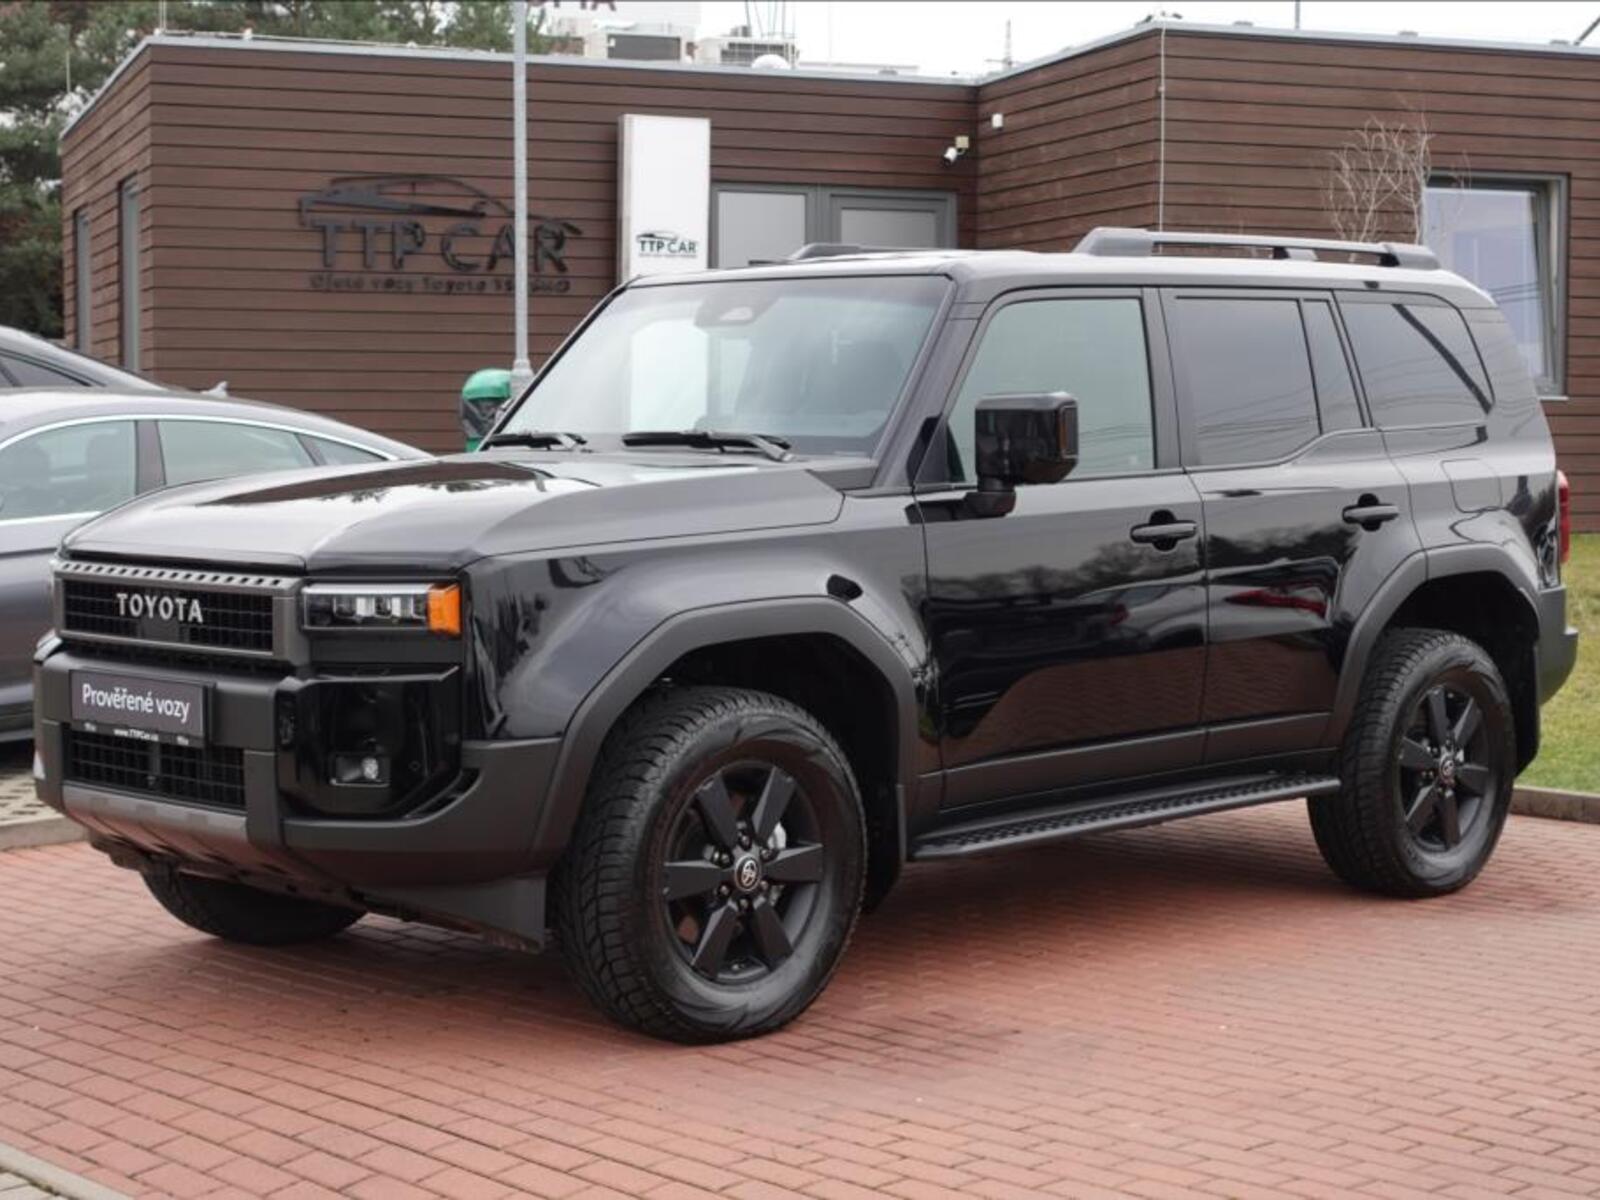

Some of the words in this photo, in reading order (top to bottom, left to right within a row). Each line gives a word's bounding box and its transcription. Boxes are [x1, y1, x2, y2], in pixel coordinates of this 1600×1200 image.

[311, 218, 425, 270] TTP
[440, 222, 569, 273] CAR
[639, 239, 665, 253] TTP
[667, 240, 697, 254] CAR
[116, 592, 204, 623] TOYOTA
[82, 683, 154, 713] Prověřené
[156, 698, 191, 723] vozy
